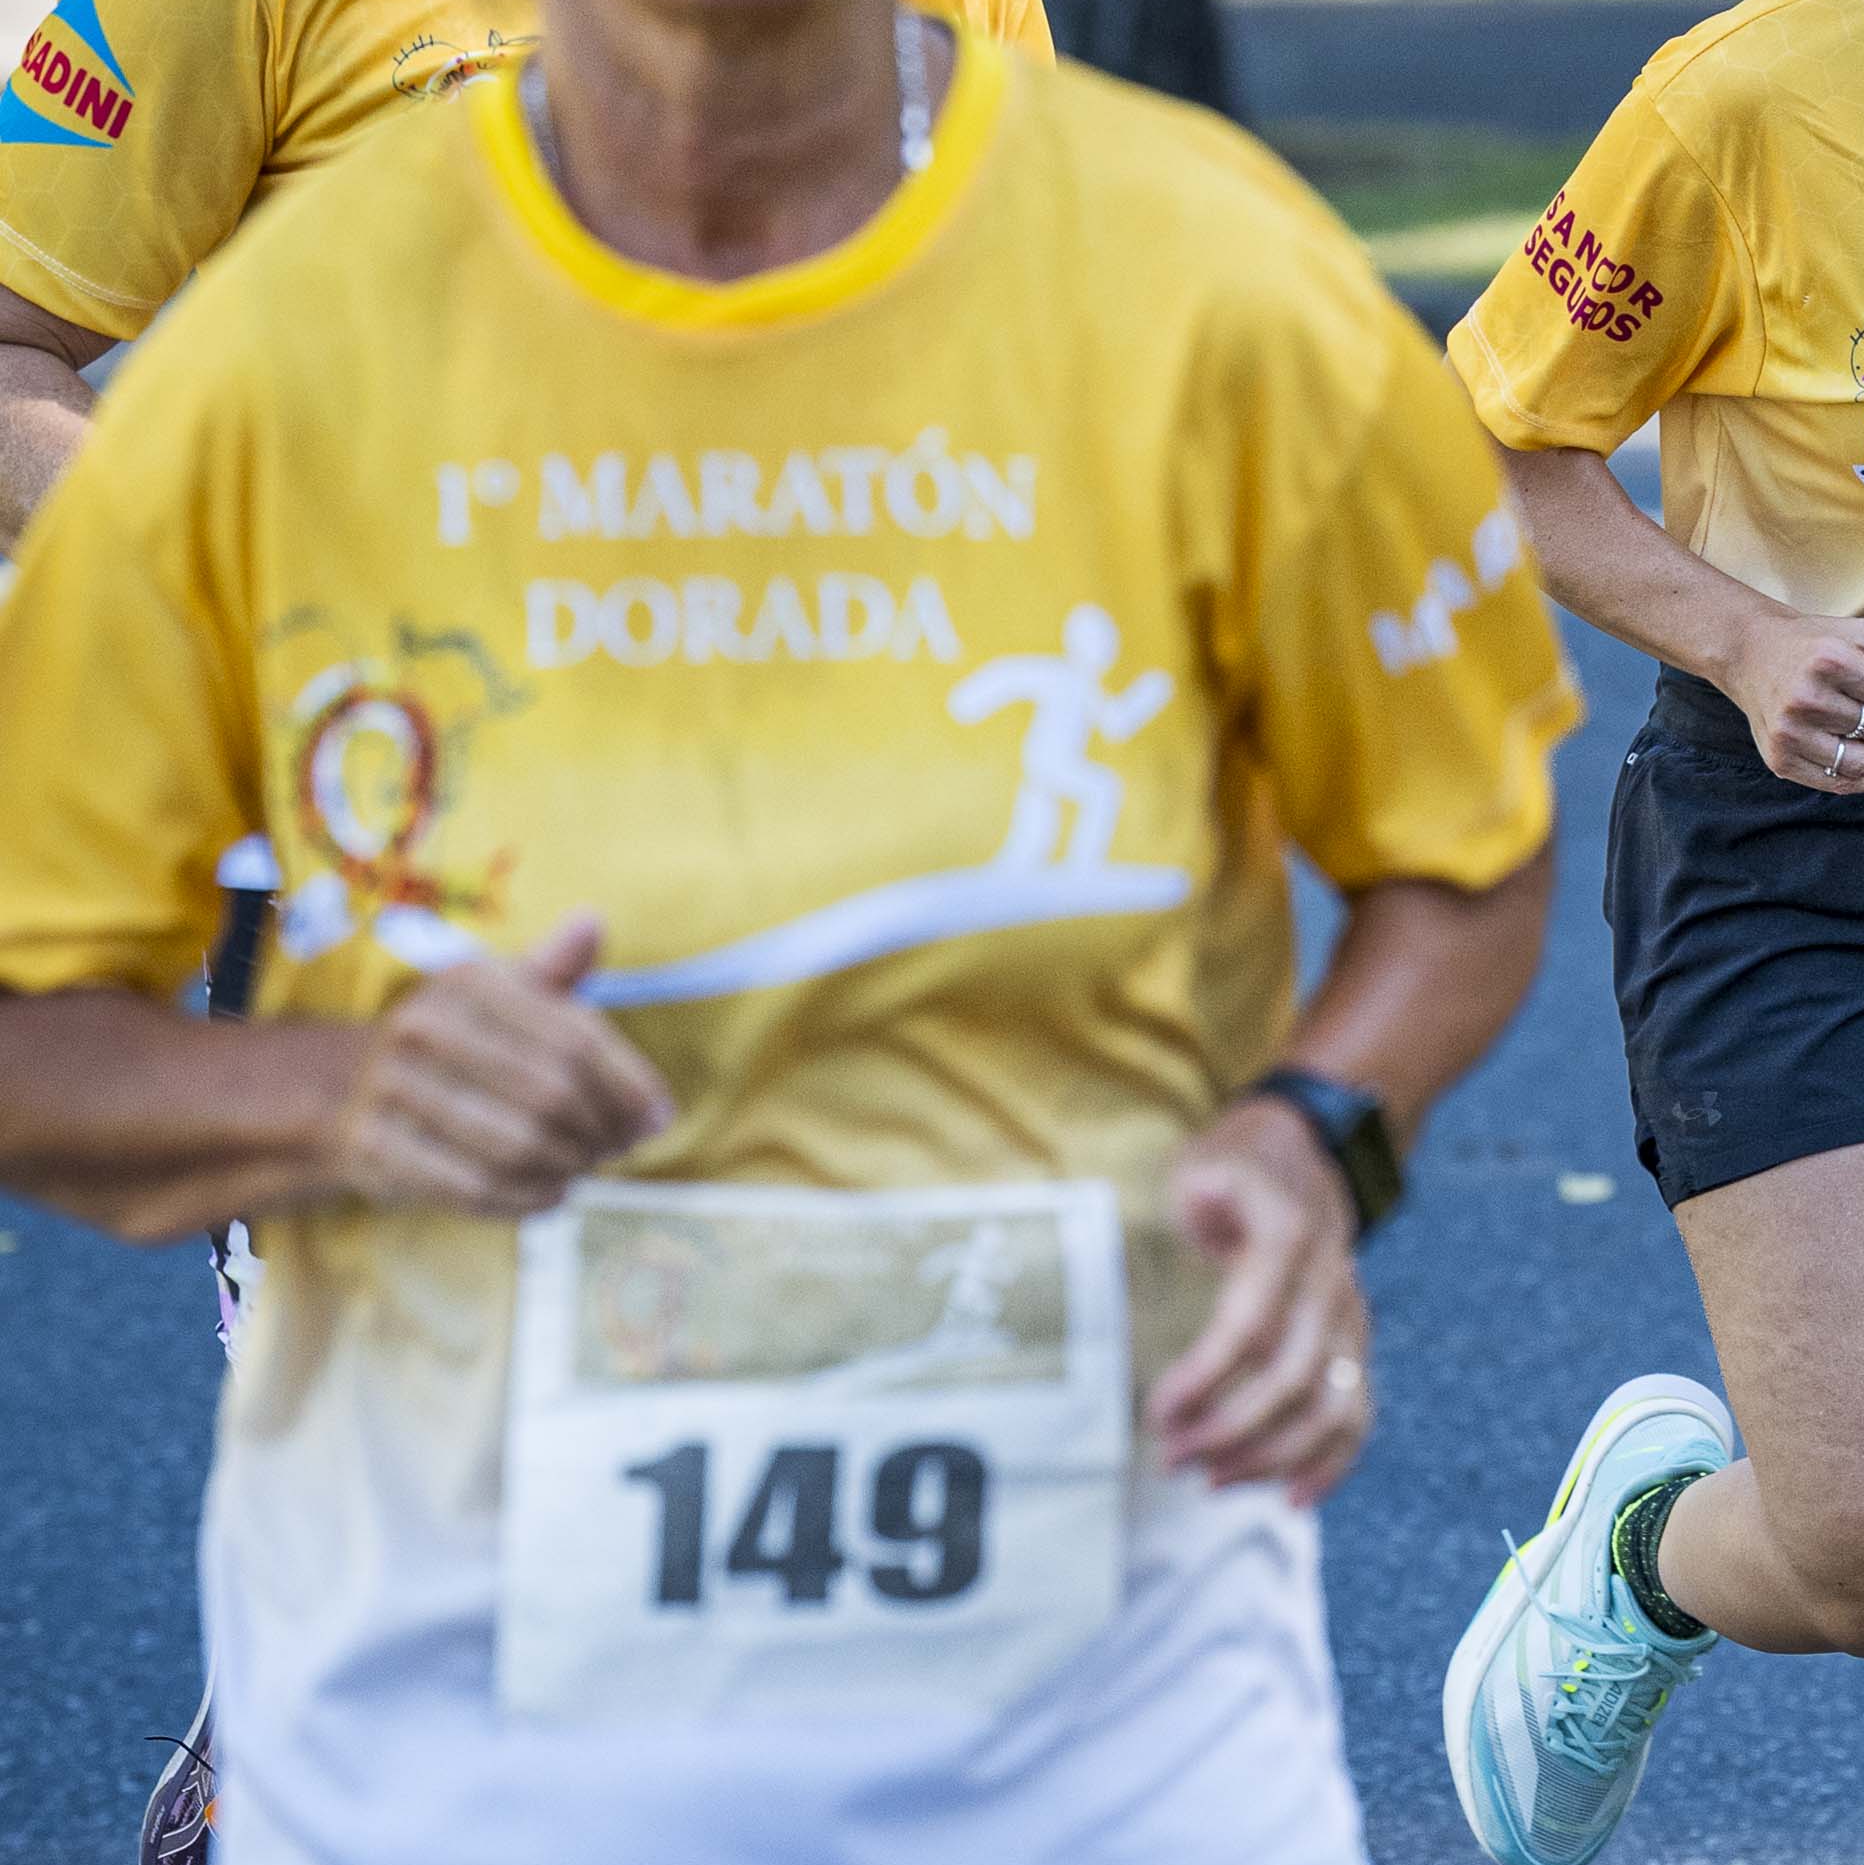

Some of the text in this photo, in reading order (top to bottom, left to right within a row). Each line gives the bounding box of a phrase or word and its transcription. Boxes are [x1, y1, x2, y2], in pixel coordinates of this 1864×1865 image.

[1524, 224, 1642, 342] SEGUROS
[1546, 190, 1664, 320] SANCOR
[538, 428, 1037, 540] MARATÓN
[525, 573, 961, 668] DORADA
[623, 1441, 988, 1612] 149
